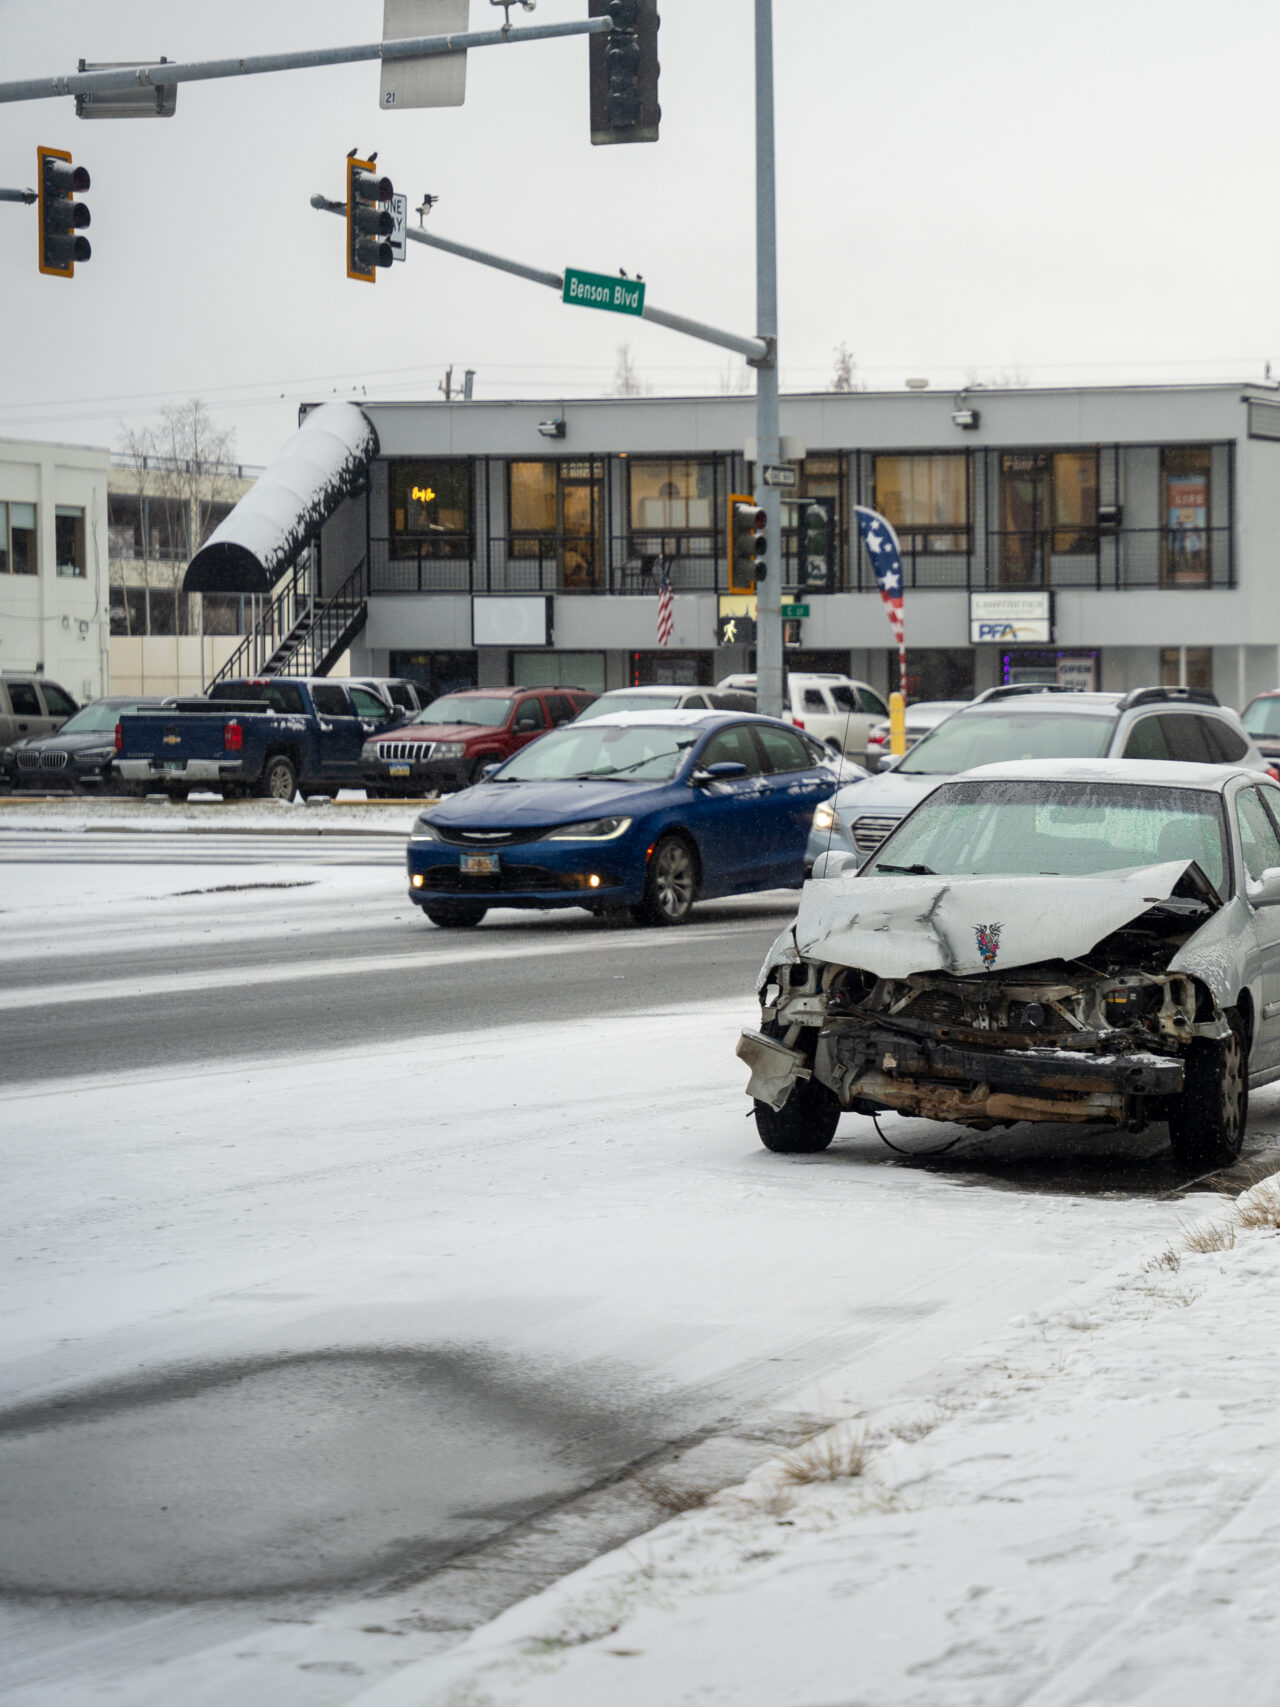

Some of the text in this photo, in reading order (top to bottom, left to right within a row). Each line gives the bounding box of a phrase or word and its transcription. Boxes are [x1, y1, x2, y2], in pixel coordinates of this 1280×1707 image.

[385, 92, 396, 103] 21
[569, 277, 639, 308] Benson Blvd
[979, 623, 1017, 639] PFA
